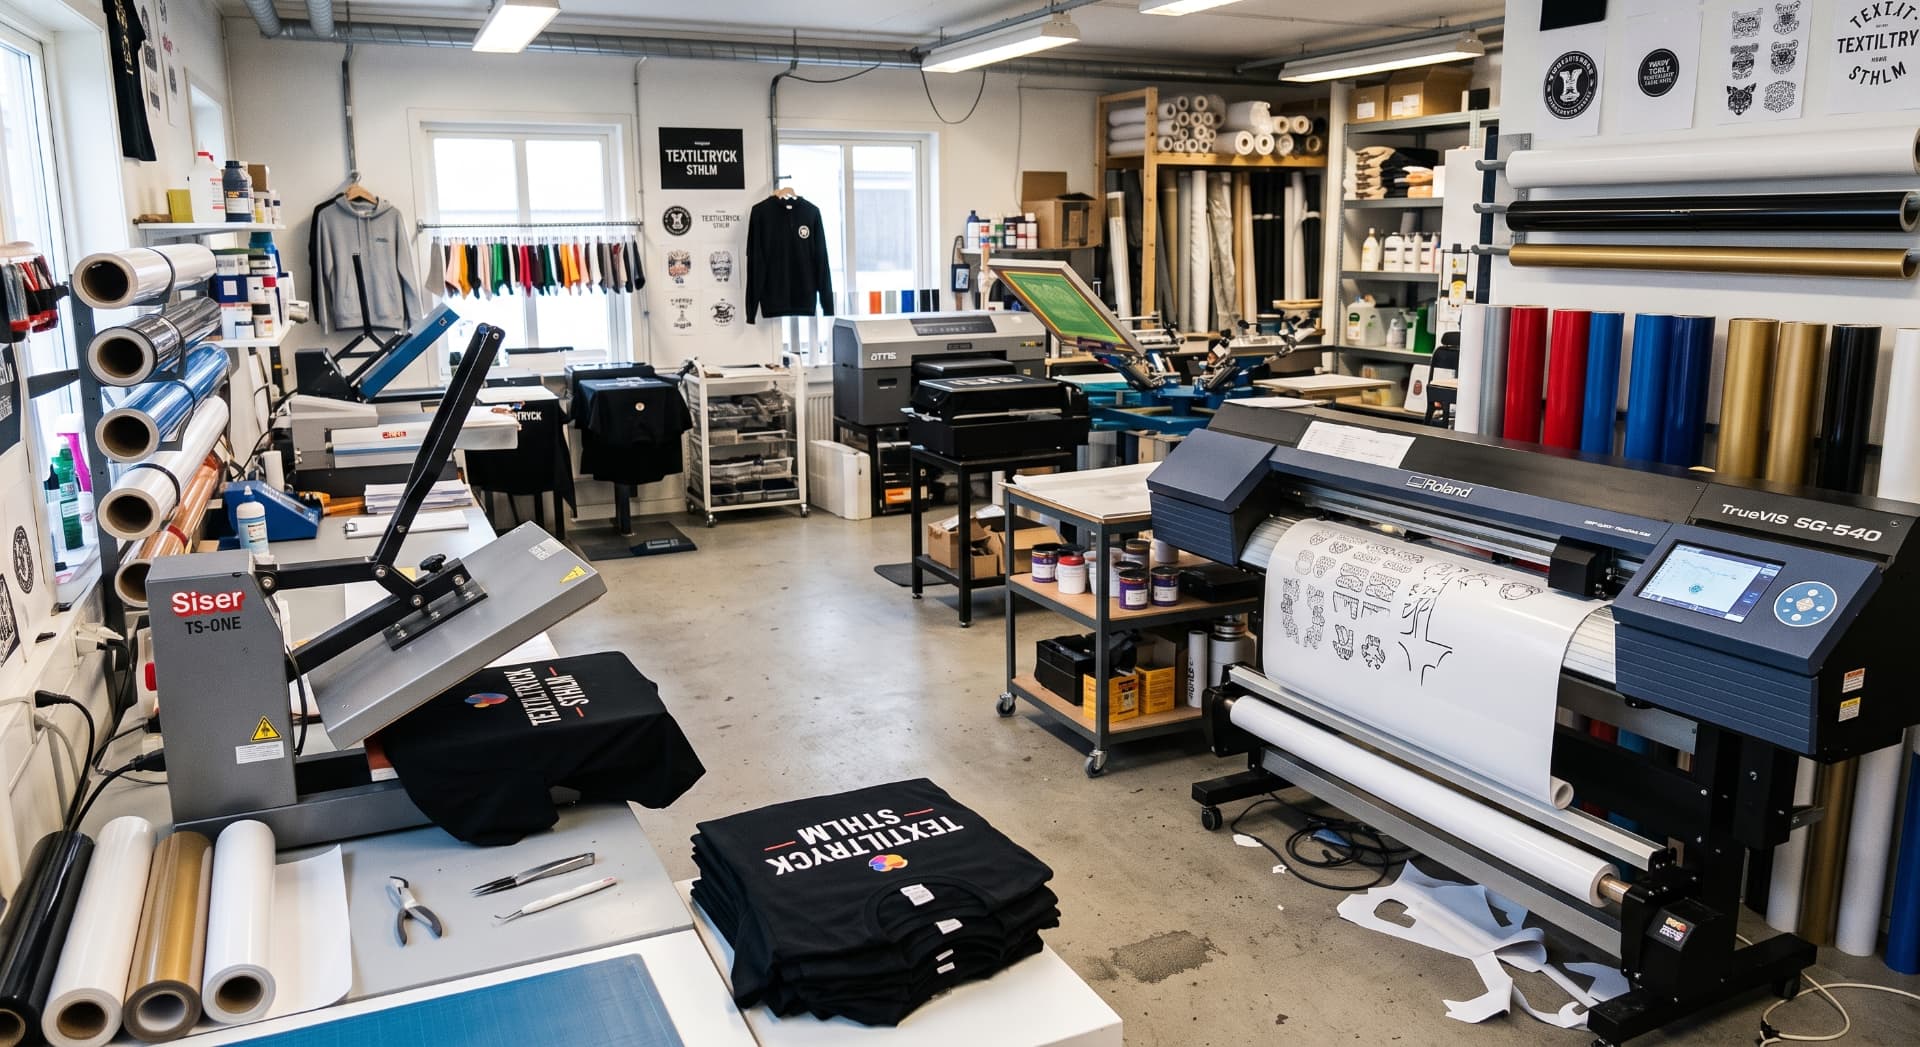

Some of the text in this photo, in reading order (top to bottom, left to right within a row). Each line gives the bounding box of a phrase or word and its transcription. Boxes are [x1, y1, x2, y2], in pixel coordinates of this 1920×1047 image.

[1848, 61, 1907, 86] STHLM
[665, 149, 738, 163] TEXTILTRYCK
[686, 164, 718, 176] STHLM
[1423, 479, 1473, 498] Roland
[1721, 504, 1882, 542] TrueVIS SG-540
[171, 591, 243, 613] Siser
[185, 616, 242, 635] TS-ONE
[504, 668, 562, 726] TEXTILTRYCK
[544, 674, 590, 707] STHLM
[797, 808, 902, 846] STHLM
[765, 815, 965, 876] TEXTILTRYCK
